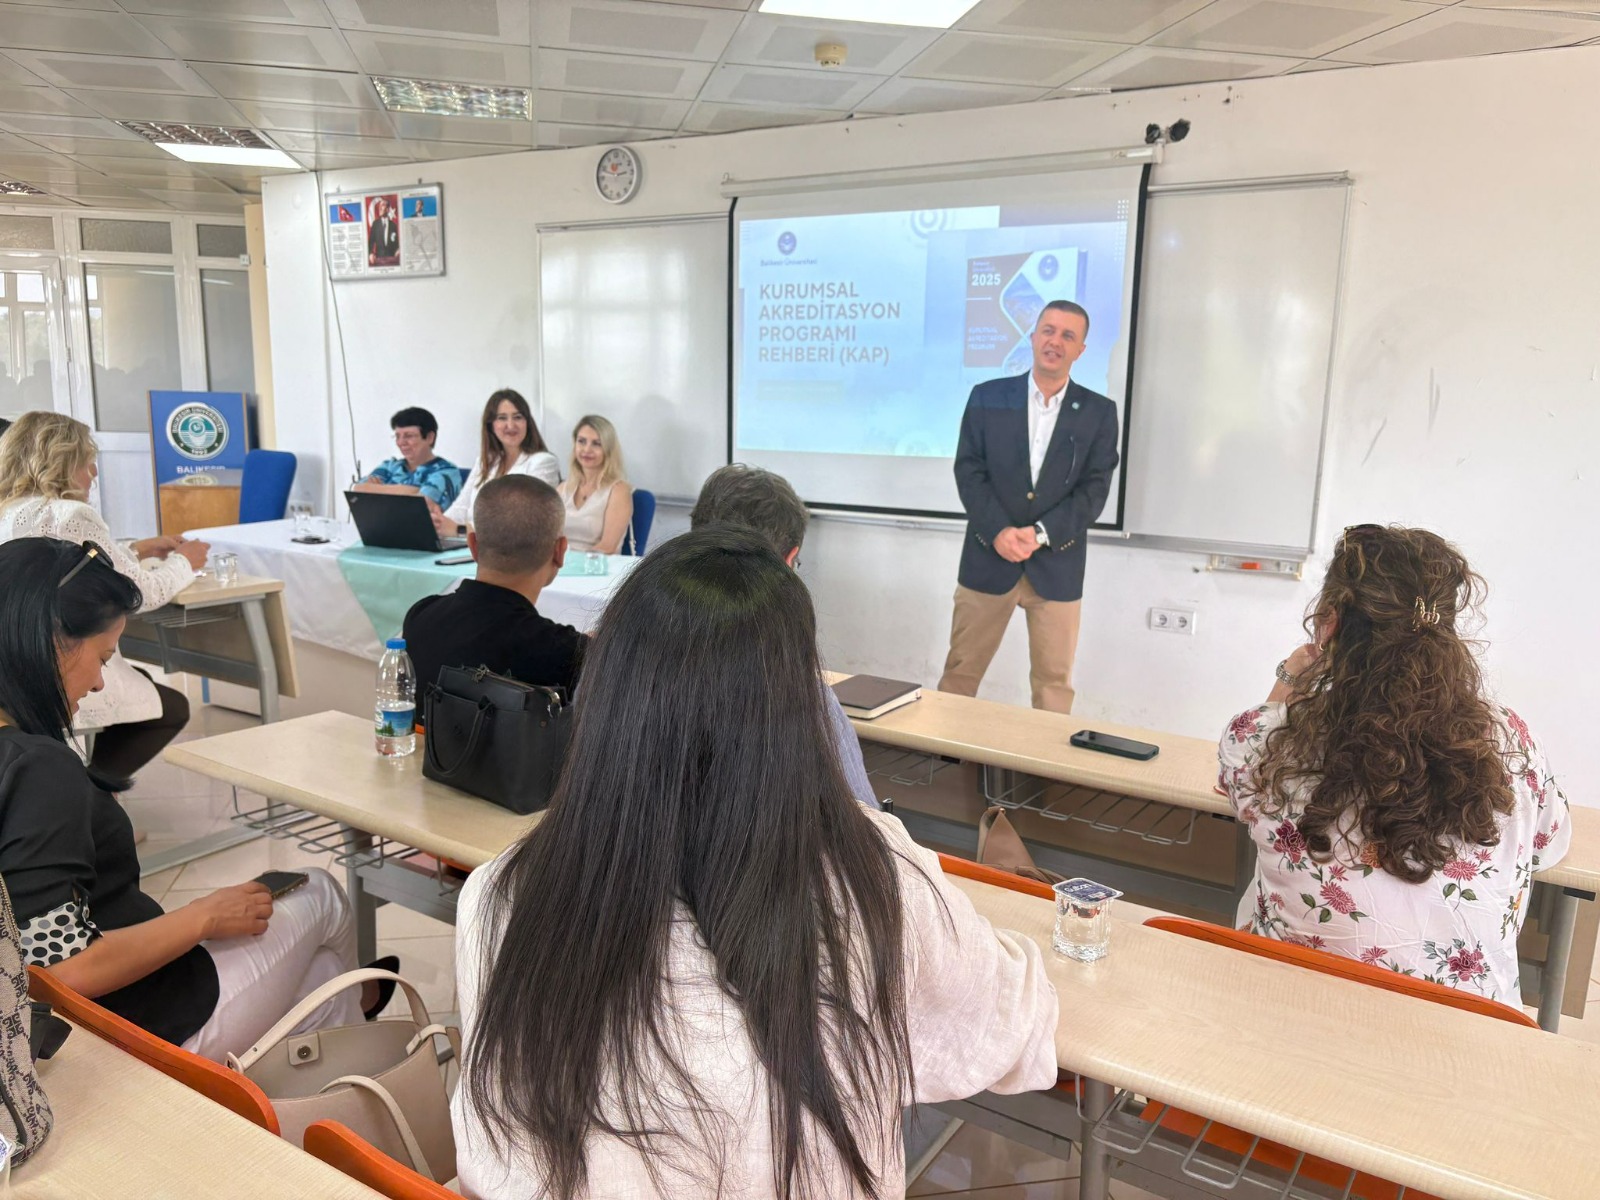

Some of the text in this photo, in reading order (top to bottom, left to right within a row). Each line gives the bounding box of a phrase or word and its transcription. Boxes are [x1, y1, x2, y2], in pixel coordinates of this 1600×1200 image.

[971, 273, 1001, 286] 2025
[759, 281, 860, 300] KURUMSAL
[758, 299, 901, 321] AKREDİTASYON
[759, 325, 856, 342] PROGRAMI
[758, 342, 889, 367] REHBERİ (KAP)
